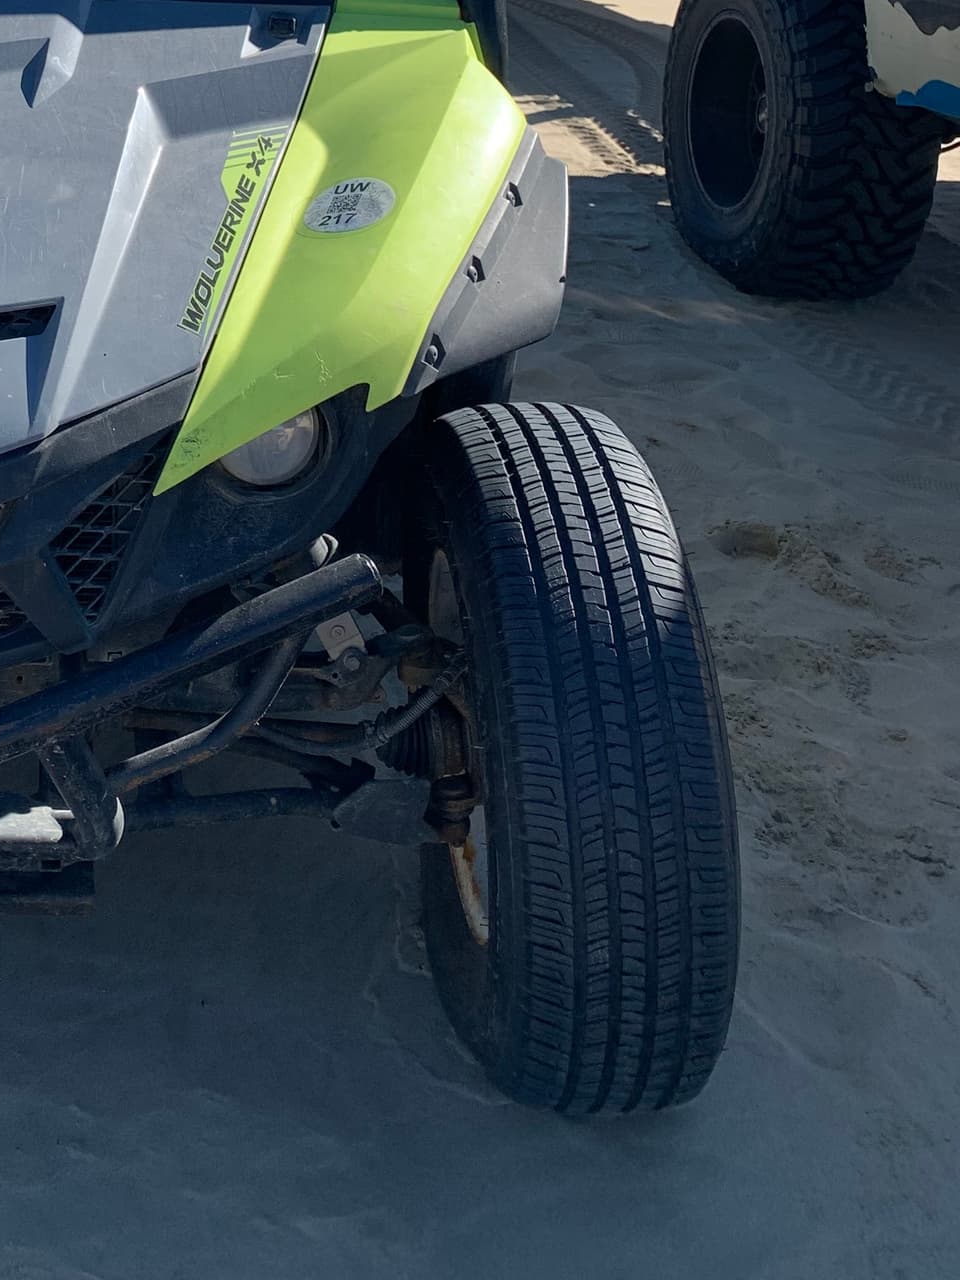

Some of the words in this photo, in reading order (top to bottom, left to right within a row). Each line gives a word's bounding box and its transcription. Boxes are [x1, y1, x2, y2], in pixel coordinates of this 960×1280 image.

[334, 181, 372, 195] UW
[318, 213, 358, 228] 217
[178, 173, 257, 334] WOLVERINE
